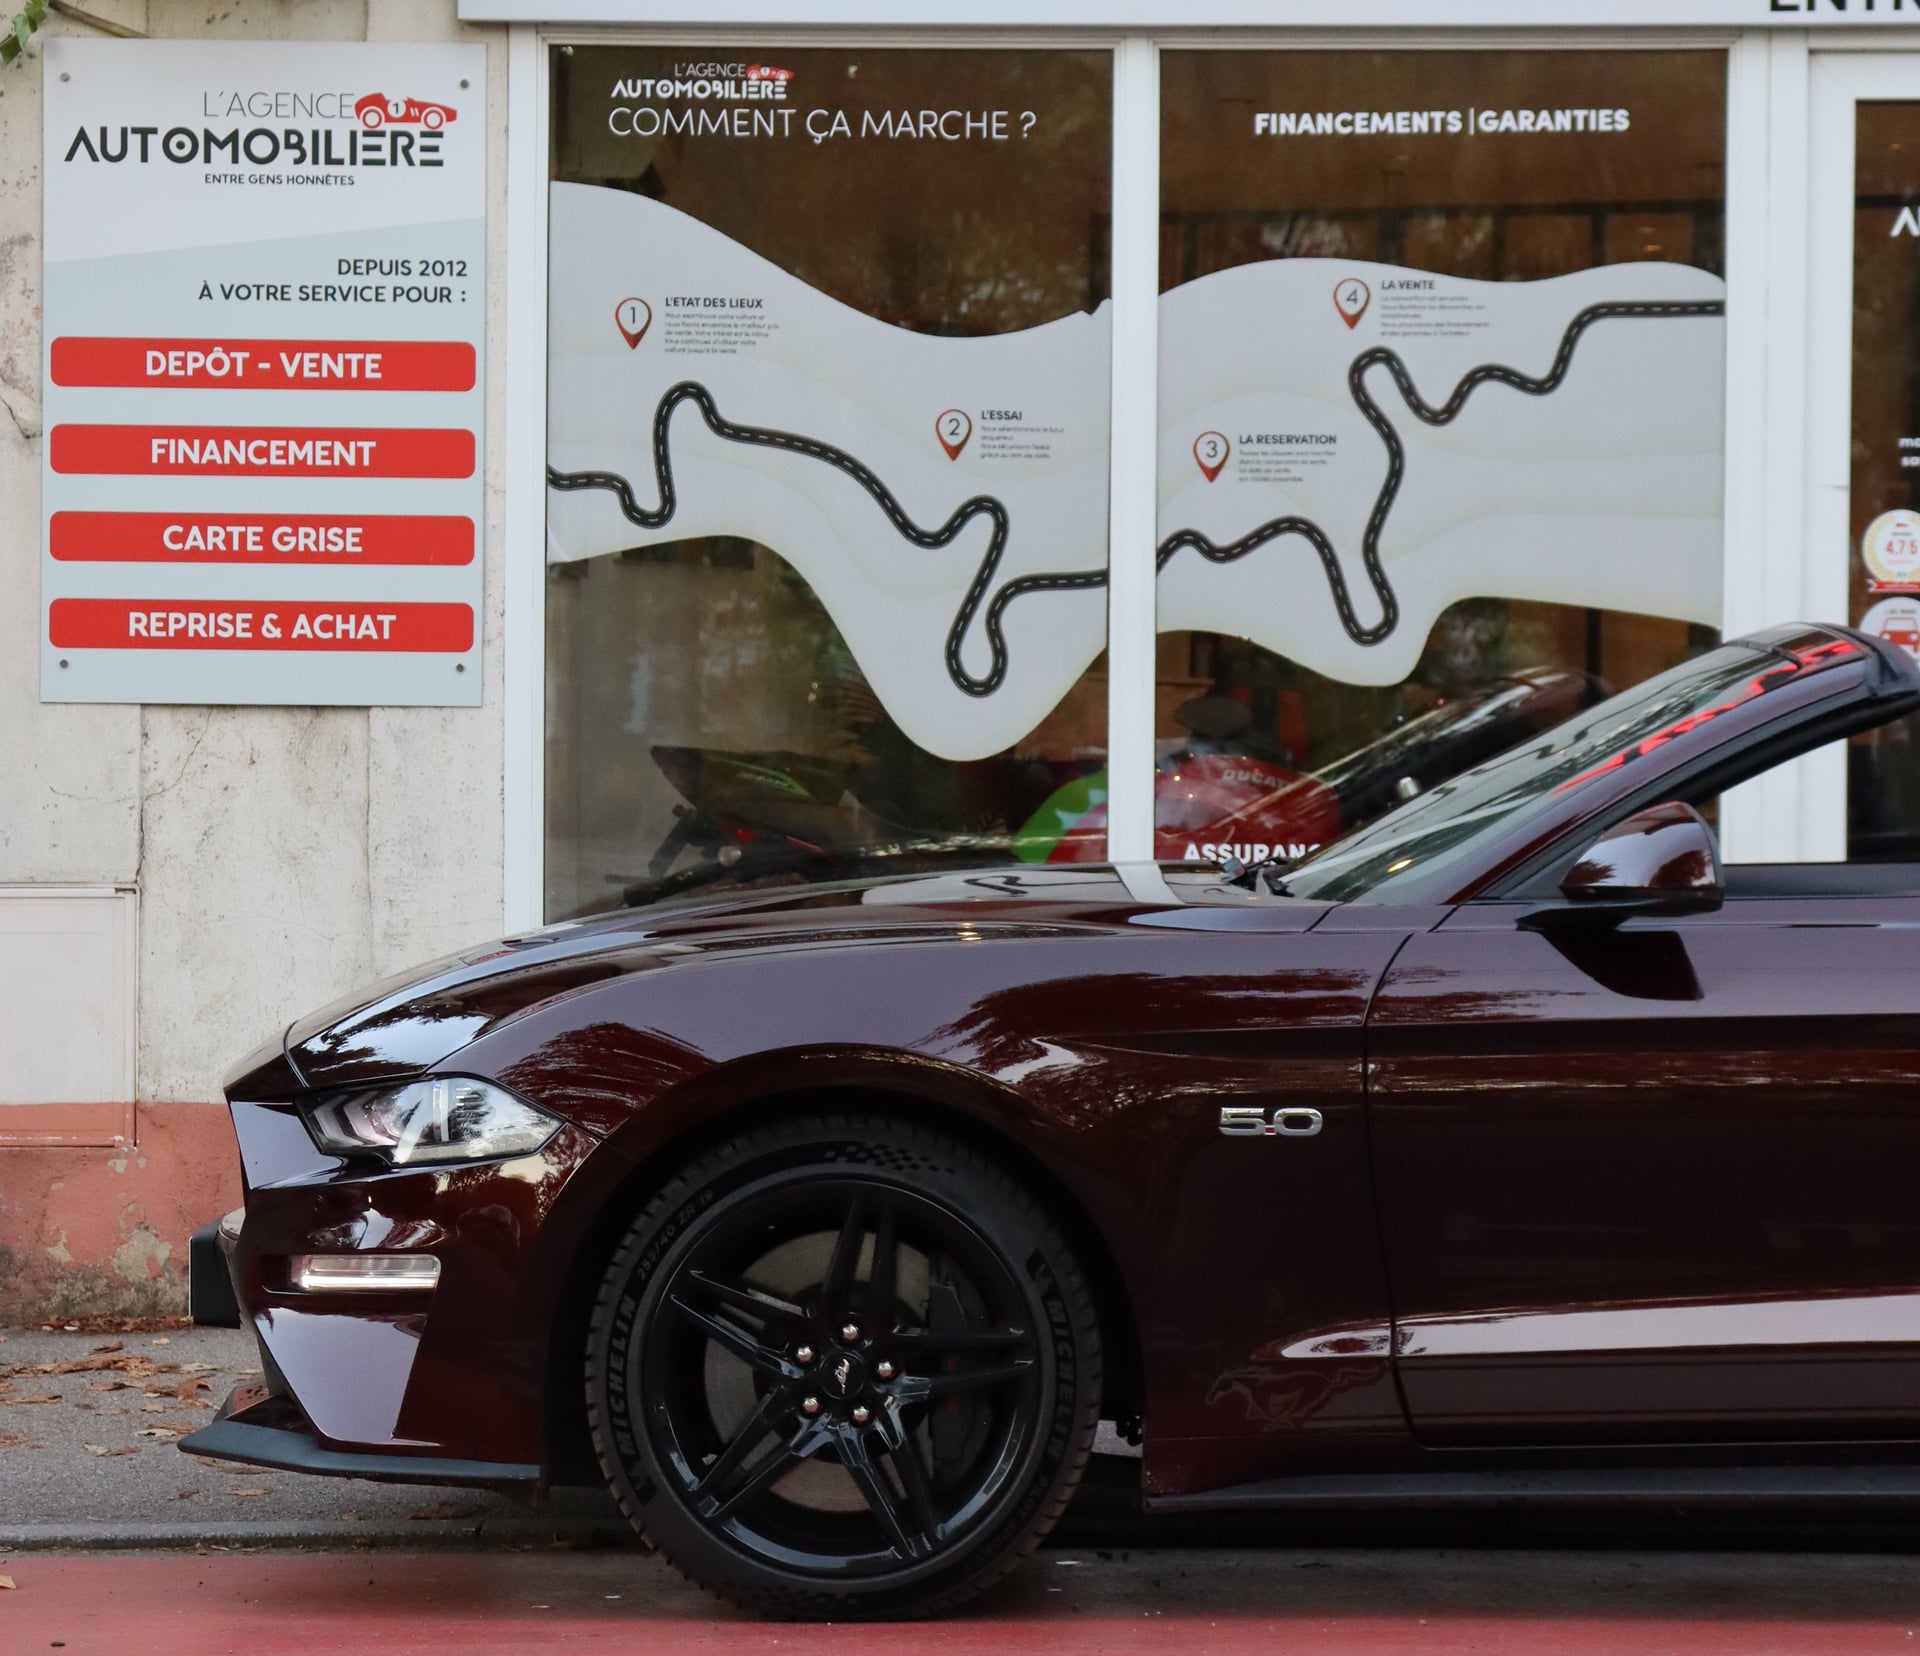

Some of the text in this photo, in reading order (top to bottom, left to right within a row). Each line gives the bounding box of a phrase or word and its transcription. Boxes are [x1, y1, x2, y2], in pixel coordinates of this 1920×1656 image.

[675, 63, 745, 77] L'AGENCE
[609, 107, 1036, 144] COMMENT ÇA MARCHE ?
[205, 174, 354, 185] ENTRE GENS HONNÊTES
[338, 259, 467, 276] DEPUIS 2012
[199, 280, 213, 300] À
[220, 284, 291, 301] VOTRE
[299, 285, 385, 302] SERVICE
[393, 286, 451, 303] POUR
[1380, 279, 1436, 290] LA VENTE
[665, 296, 763, 310] L'ETAT DES LIEUX
[1345, 287, 1359, 305] 4
[629, 306, 636, 325] 1
[146, 347, 249, 376] DEPÔT
[280, 353, 382, 378] VENTE
[982, 410, 1022, 420] L'ESSAI
[949, 418, 960, 436] 2
[1206, 439, 1218, 458] 3
[1239, 434, 1337, 445] LA RESERVATION
[152, 439, 376, 466] FINANCEMENT
[163, 525, 362, 552] CARTE GRISE
[129, 612, 396, 639] REPRISE & ACHAT
[1219, 1107, 1323, 1136] 5.0
[609, 1294, 638, 1457] MICHELIN
